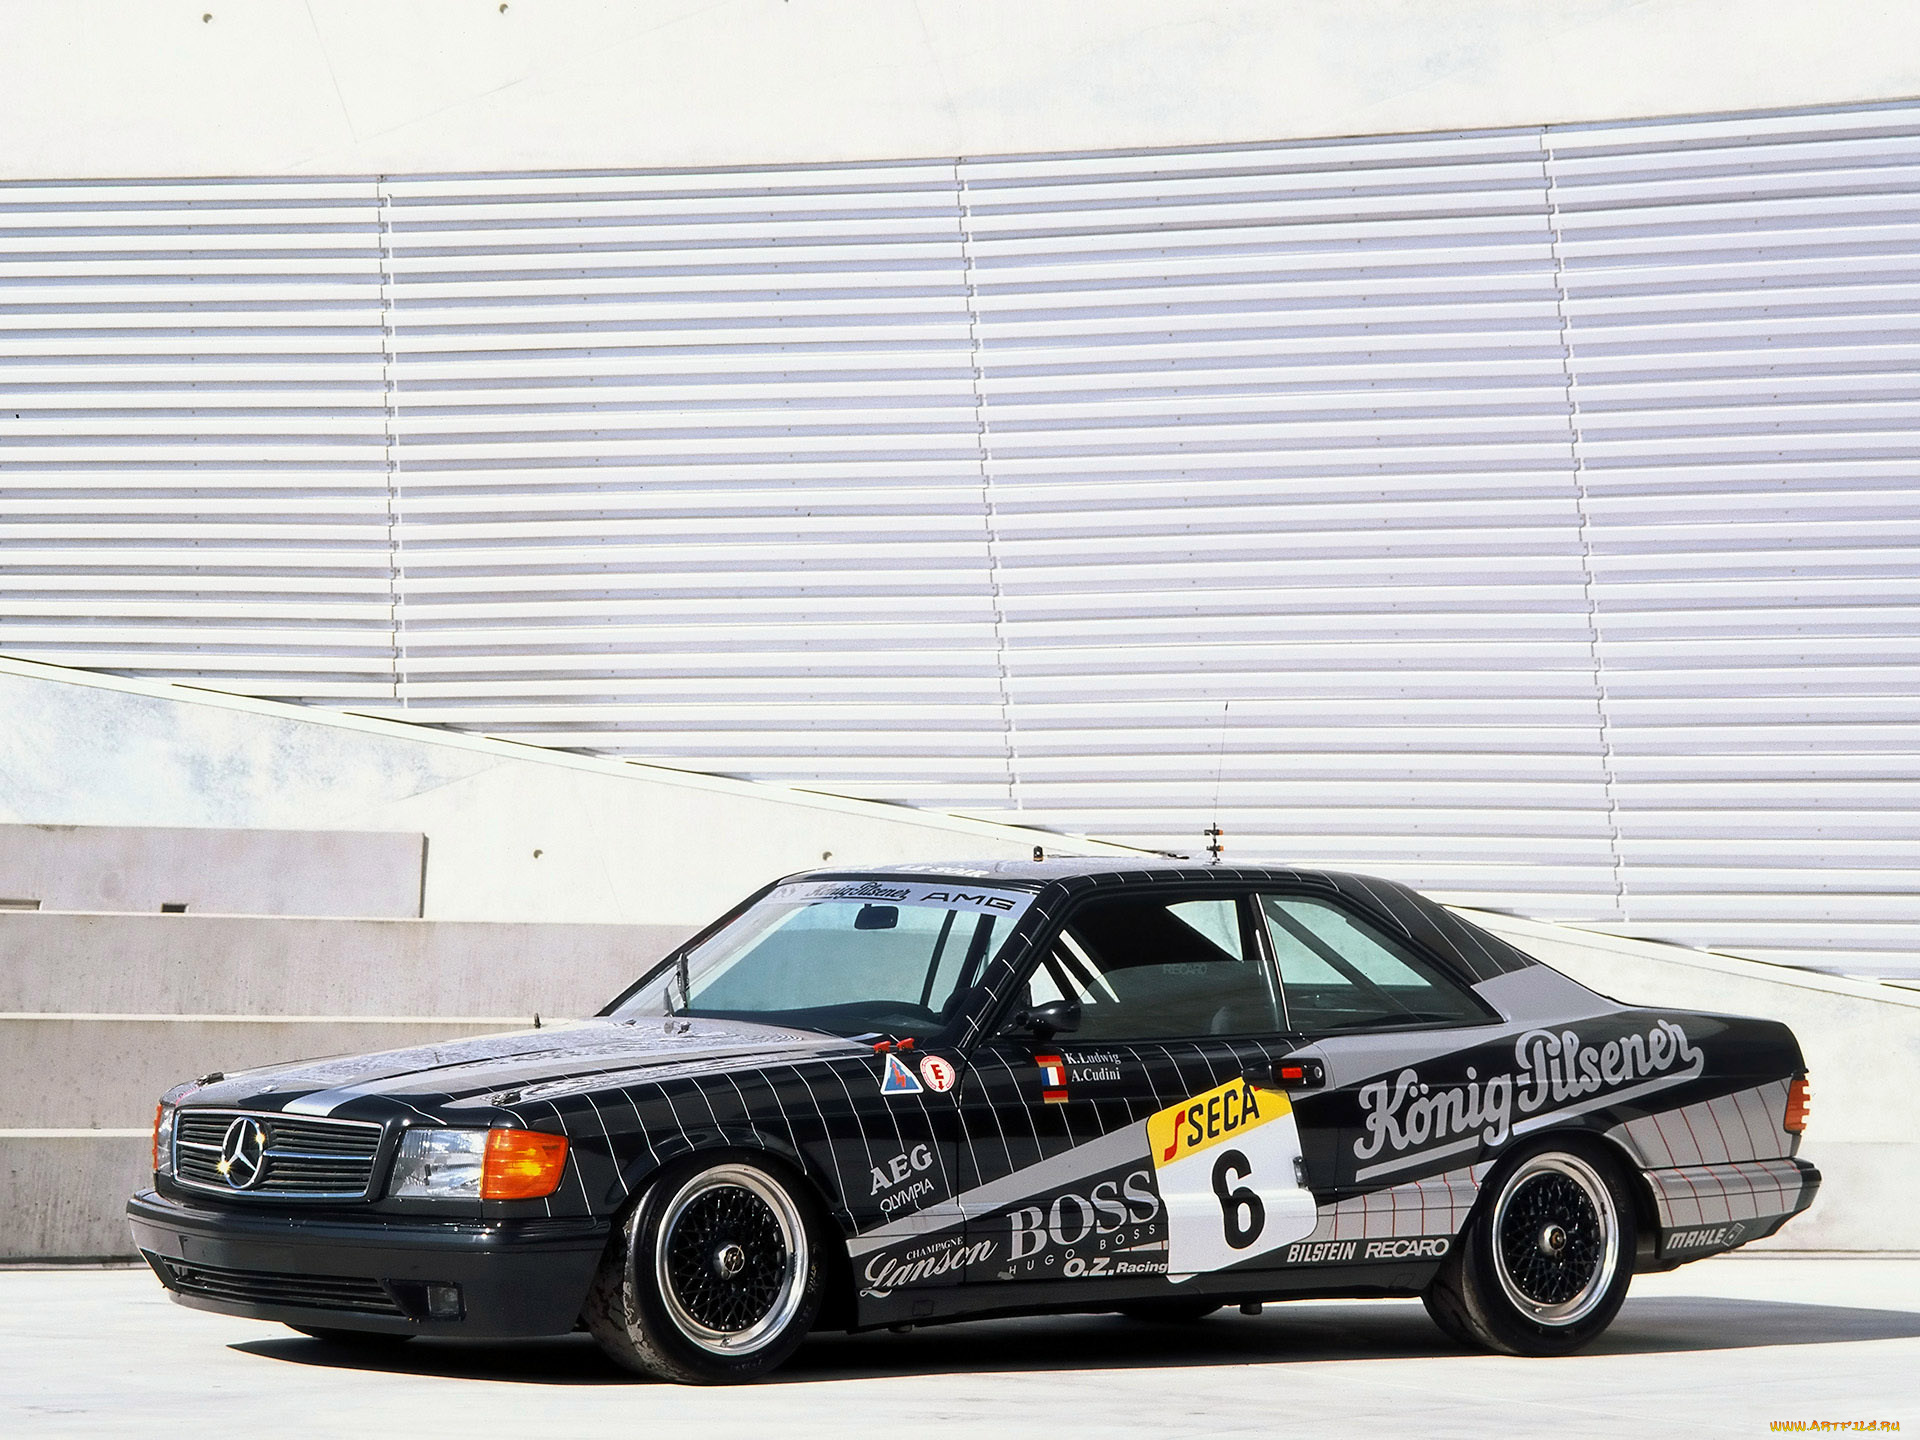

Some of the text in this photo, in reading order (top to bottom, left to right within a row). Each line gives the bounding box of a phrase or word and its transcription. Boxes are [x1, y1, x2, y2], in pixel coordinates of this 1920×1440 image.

[920, 892, 1017, 911] AMG
[1163, 963, 1208, 975] RECARO
[930, 1063, 945, 1080] E
[1353, 1019, 1704, 1160] König-Pilsener
[1187, 1080, 1261, 1147] SECA
[870, 1143, 933, 1196] AEG
[879, 1178, 935, 1213] OLYMPIA
[1006, 1170, 1159, 1263] BOSS
[1211, 1148, 1266, 1250] 6
[906, 1235, 964, 1260] CHAMPAGNE
[1009, 1224, 1156, 1276] HUGO BOSS
[1286, 1238, 1450, 1263] BILSTEIN RECARO
[1666, 1228, 1727, 1250] MAHLE
[860, 1239, 999, 1298] Lanson
